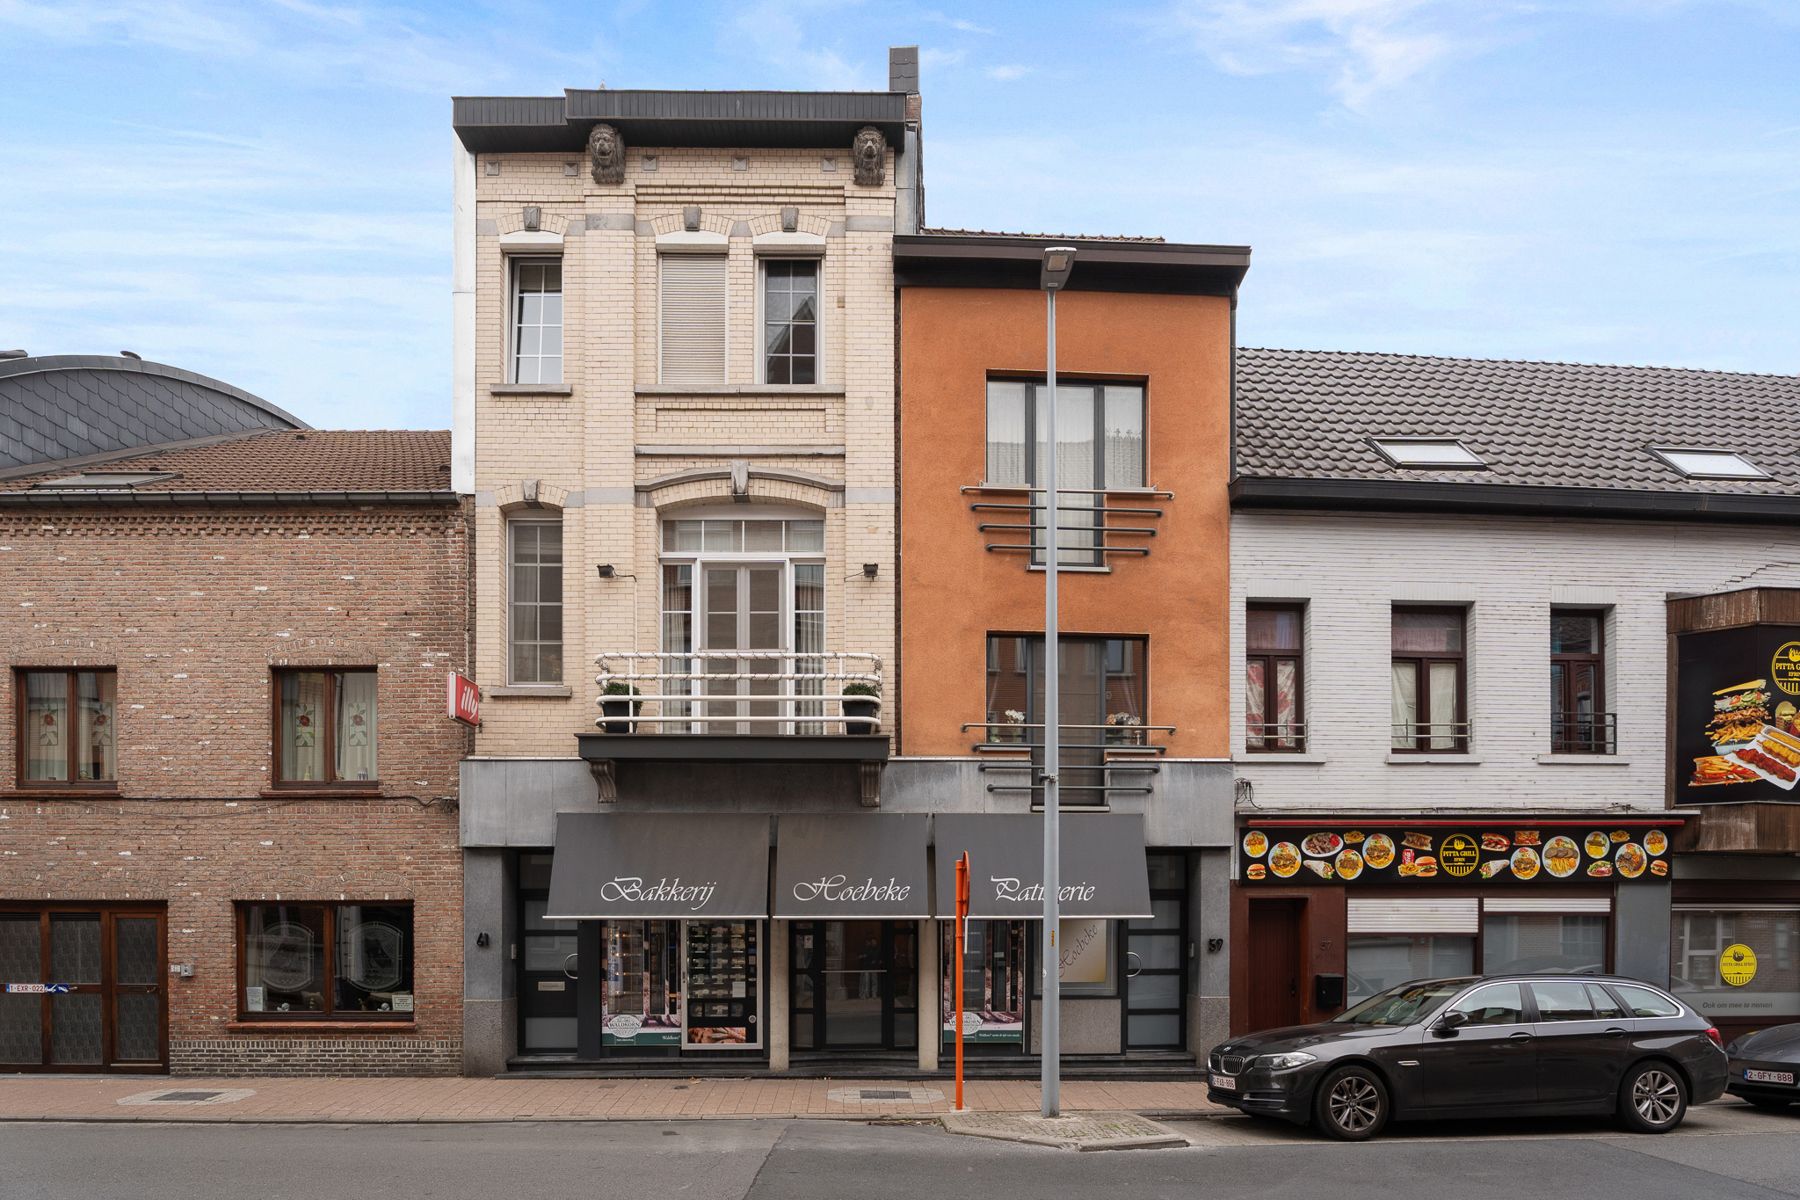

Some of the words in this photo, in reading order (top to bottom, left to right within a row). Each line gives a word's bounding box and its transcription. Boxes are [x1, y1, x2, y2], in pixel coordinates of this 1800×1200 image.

[1776, 662, 1794, 670] PITTA
[461, 685, 478, 720] illy
[600, 876, 718, 910] Bakkerij
[793, 874, 911, 901] Hoebeke
[990, 875, 1096, 902] Patierie
[476, 932, 490, 948] 61
[1208, 938, 1224, 952] 59
[1748, 1071, 1793, 1082] 2-GFY-888
